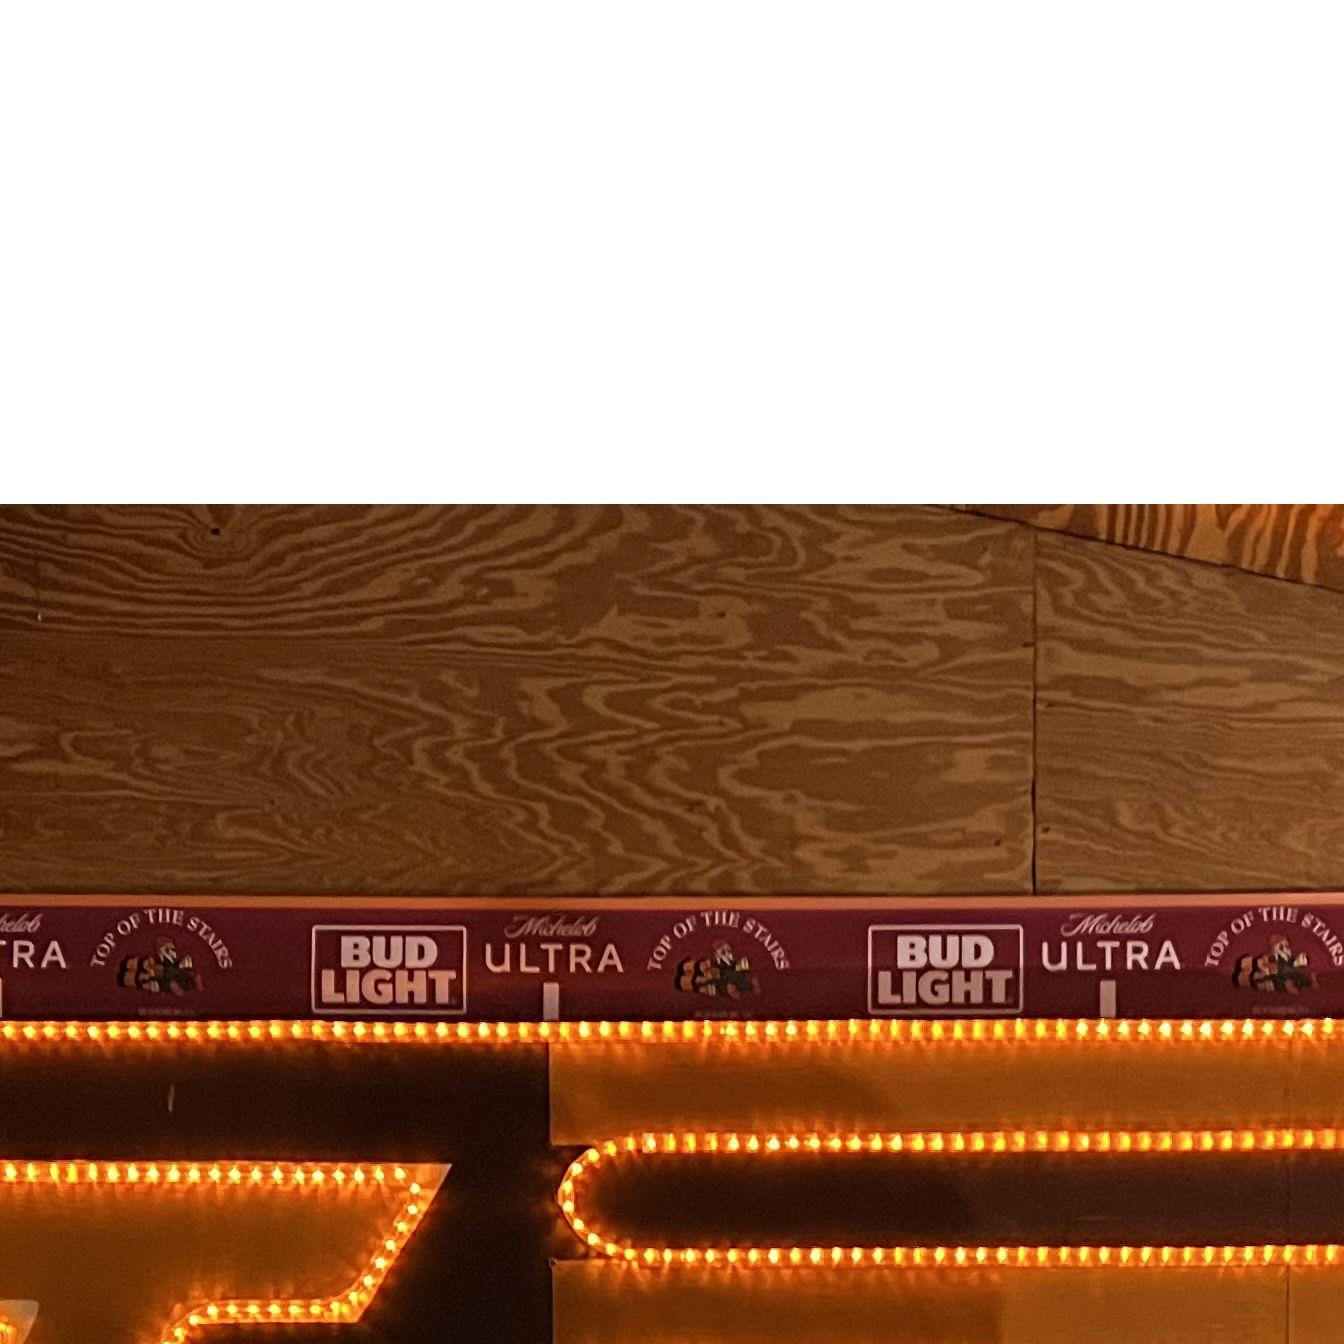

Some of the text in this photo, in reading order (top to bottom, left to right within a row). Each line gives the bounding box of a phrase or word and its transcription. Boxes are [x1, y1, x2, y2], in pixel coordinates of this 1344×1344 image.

[90, 908, 233, 970] TOP OF THE STAIRS
[503, 915, 600, 938] Michelob
[646, 910, 790, 971] TOP OF THE STAIRS
[1059, 912, 1156, 936] Michelob
[1204, 930, 1230, 967] TOP
[1231, 910, 1255, 935] OF
[1258, 905, 1299, 923] THE
[340, 935, 438, 969] BUD
[485, 942, 624, 974] ULTRA
[896, 935, 995, 969] BUD
[1041, 940, 1181, 971] ULTRA
[321, 969, 457, 1004] LIGHT
[877, 969, 1014, 1005] LIGHT
